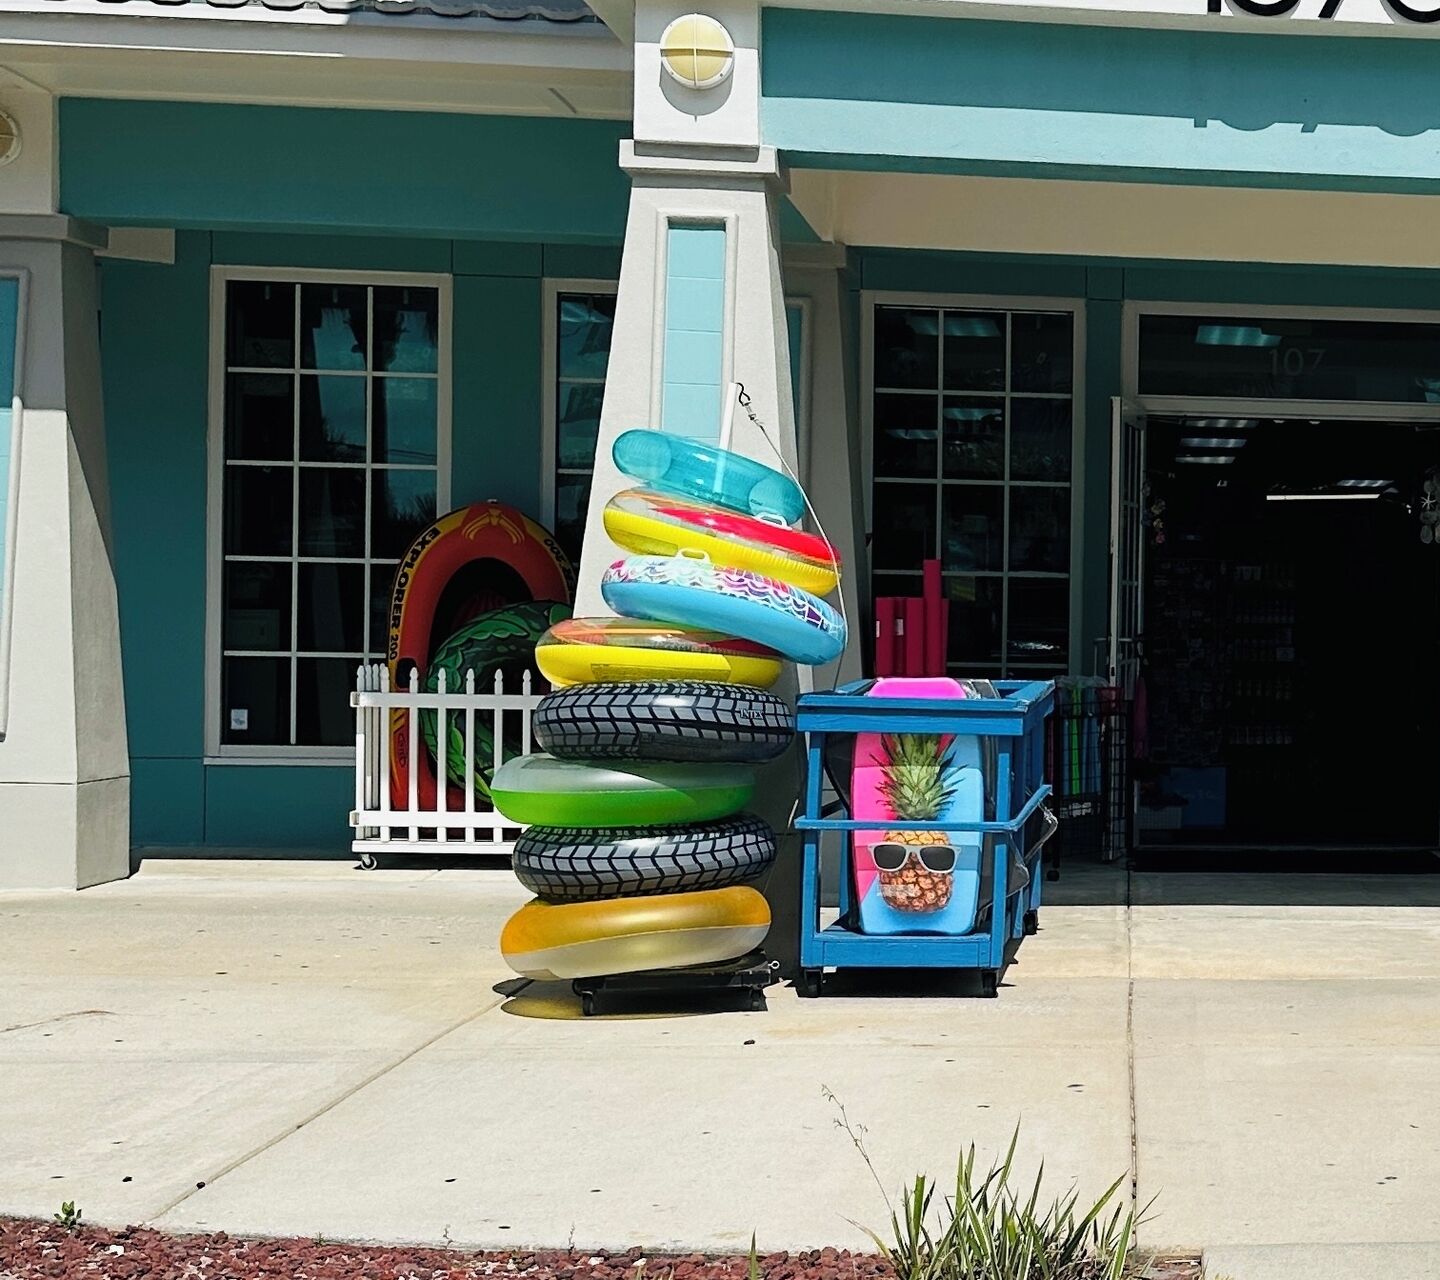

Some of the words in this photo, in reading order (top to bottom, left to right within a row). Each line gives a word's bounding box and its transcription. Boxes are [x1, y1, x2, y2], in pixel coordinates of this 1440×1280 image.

[1269, 347, 1327, 377] 107
[391, 526, 441, 628] EXPLORER
[389, 634, 399, 661] 200
